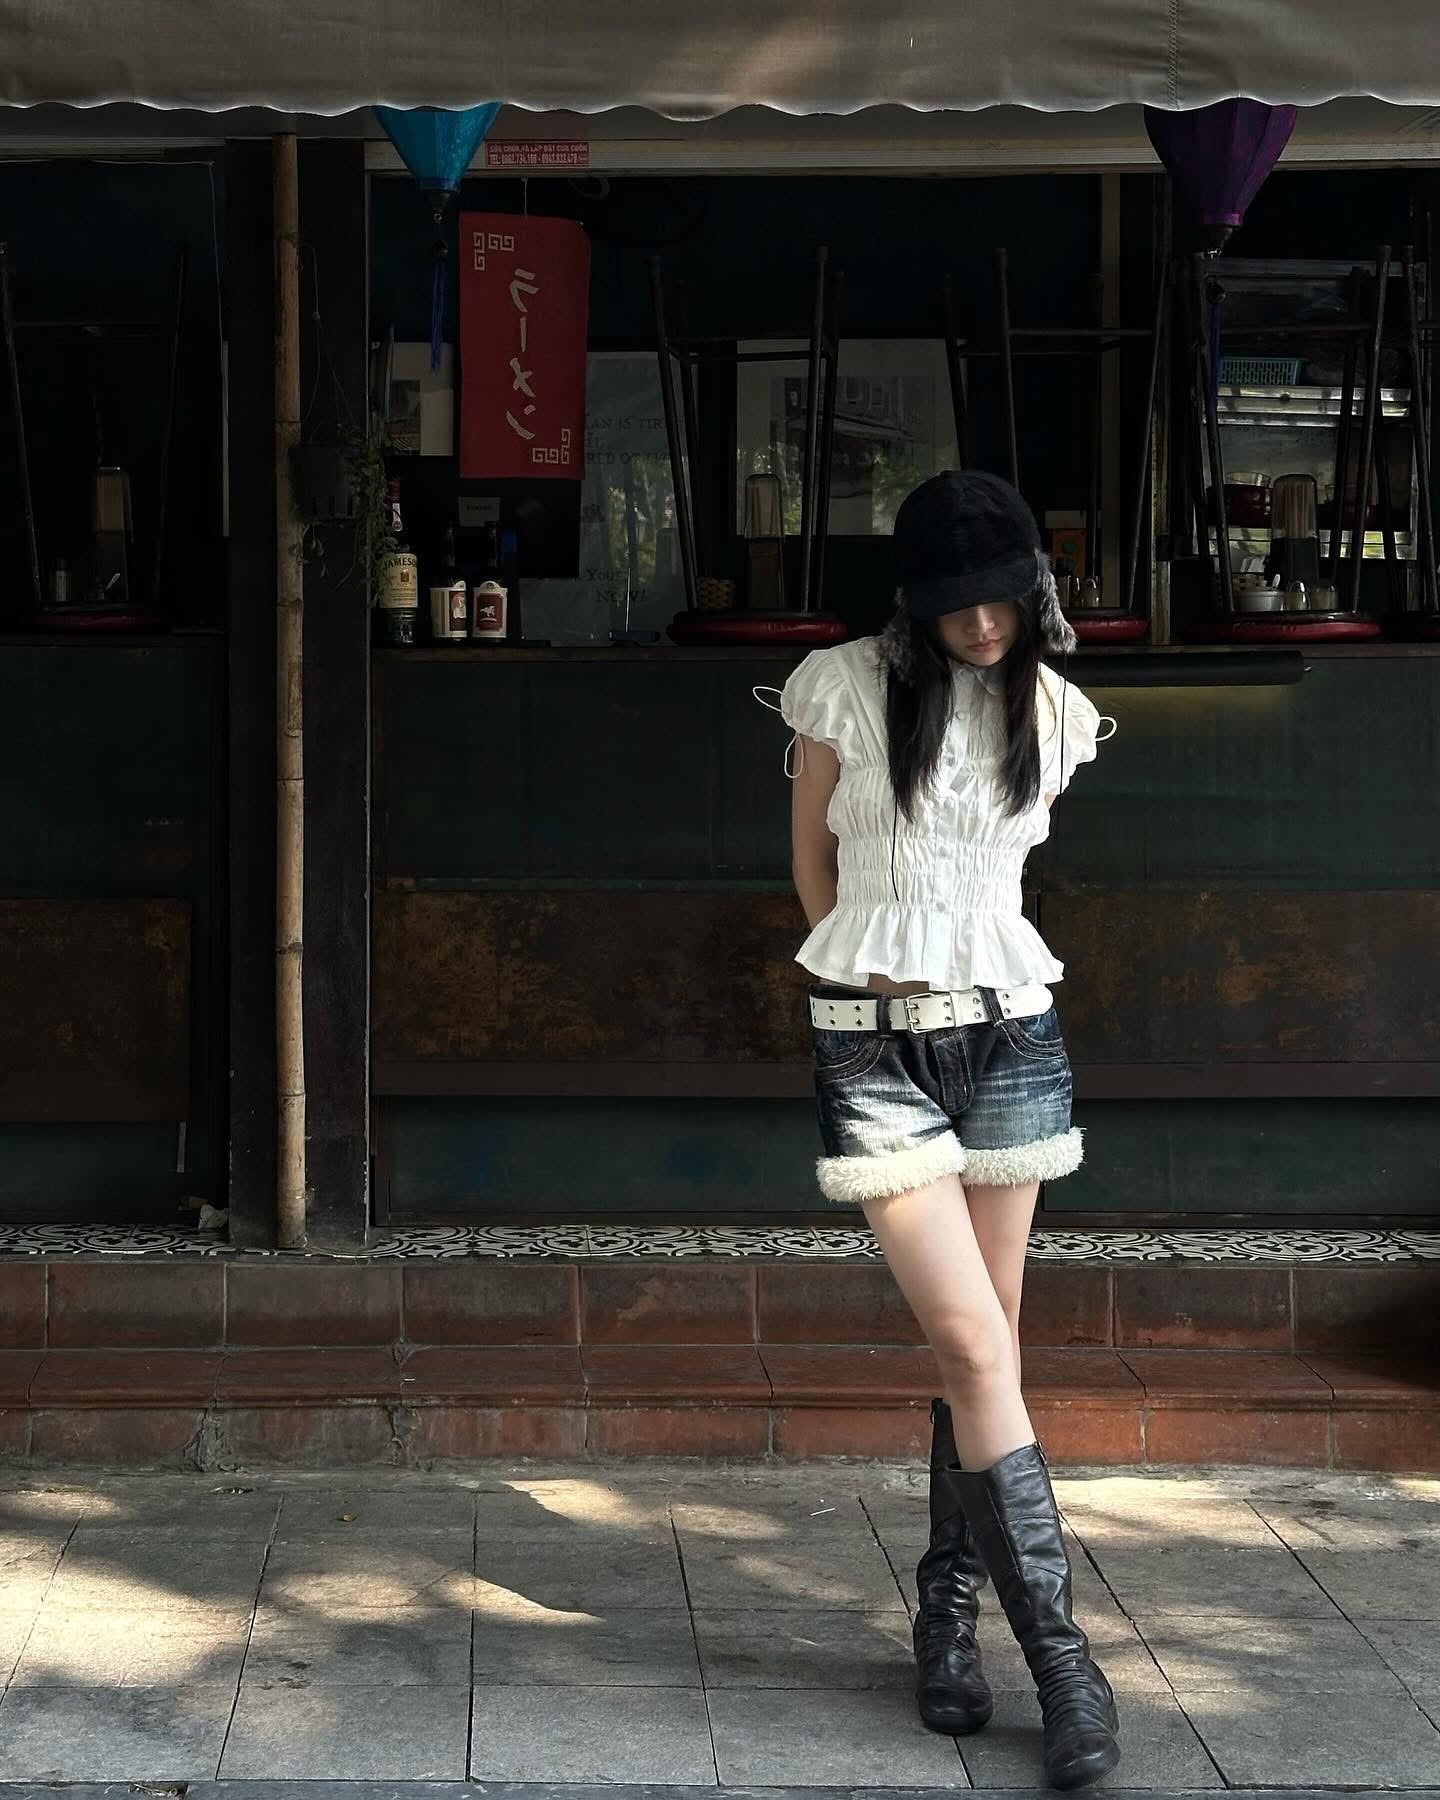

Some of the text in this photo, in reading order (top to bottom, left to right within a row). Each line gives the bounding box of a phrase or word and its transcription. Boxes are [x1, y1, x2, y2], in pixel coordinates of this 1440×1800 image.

[505, 267, 540, 440] ラーメン
[588, 416, 612, 430] AN
